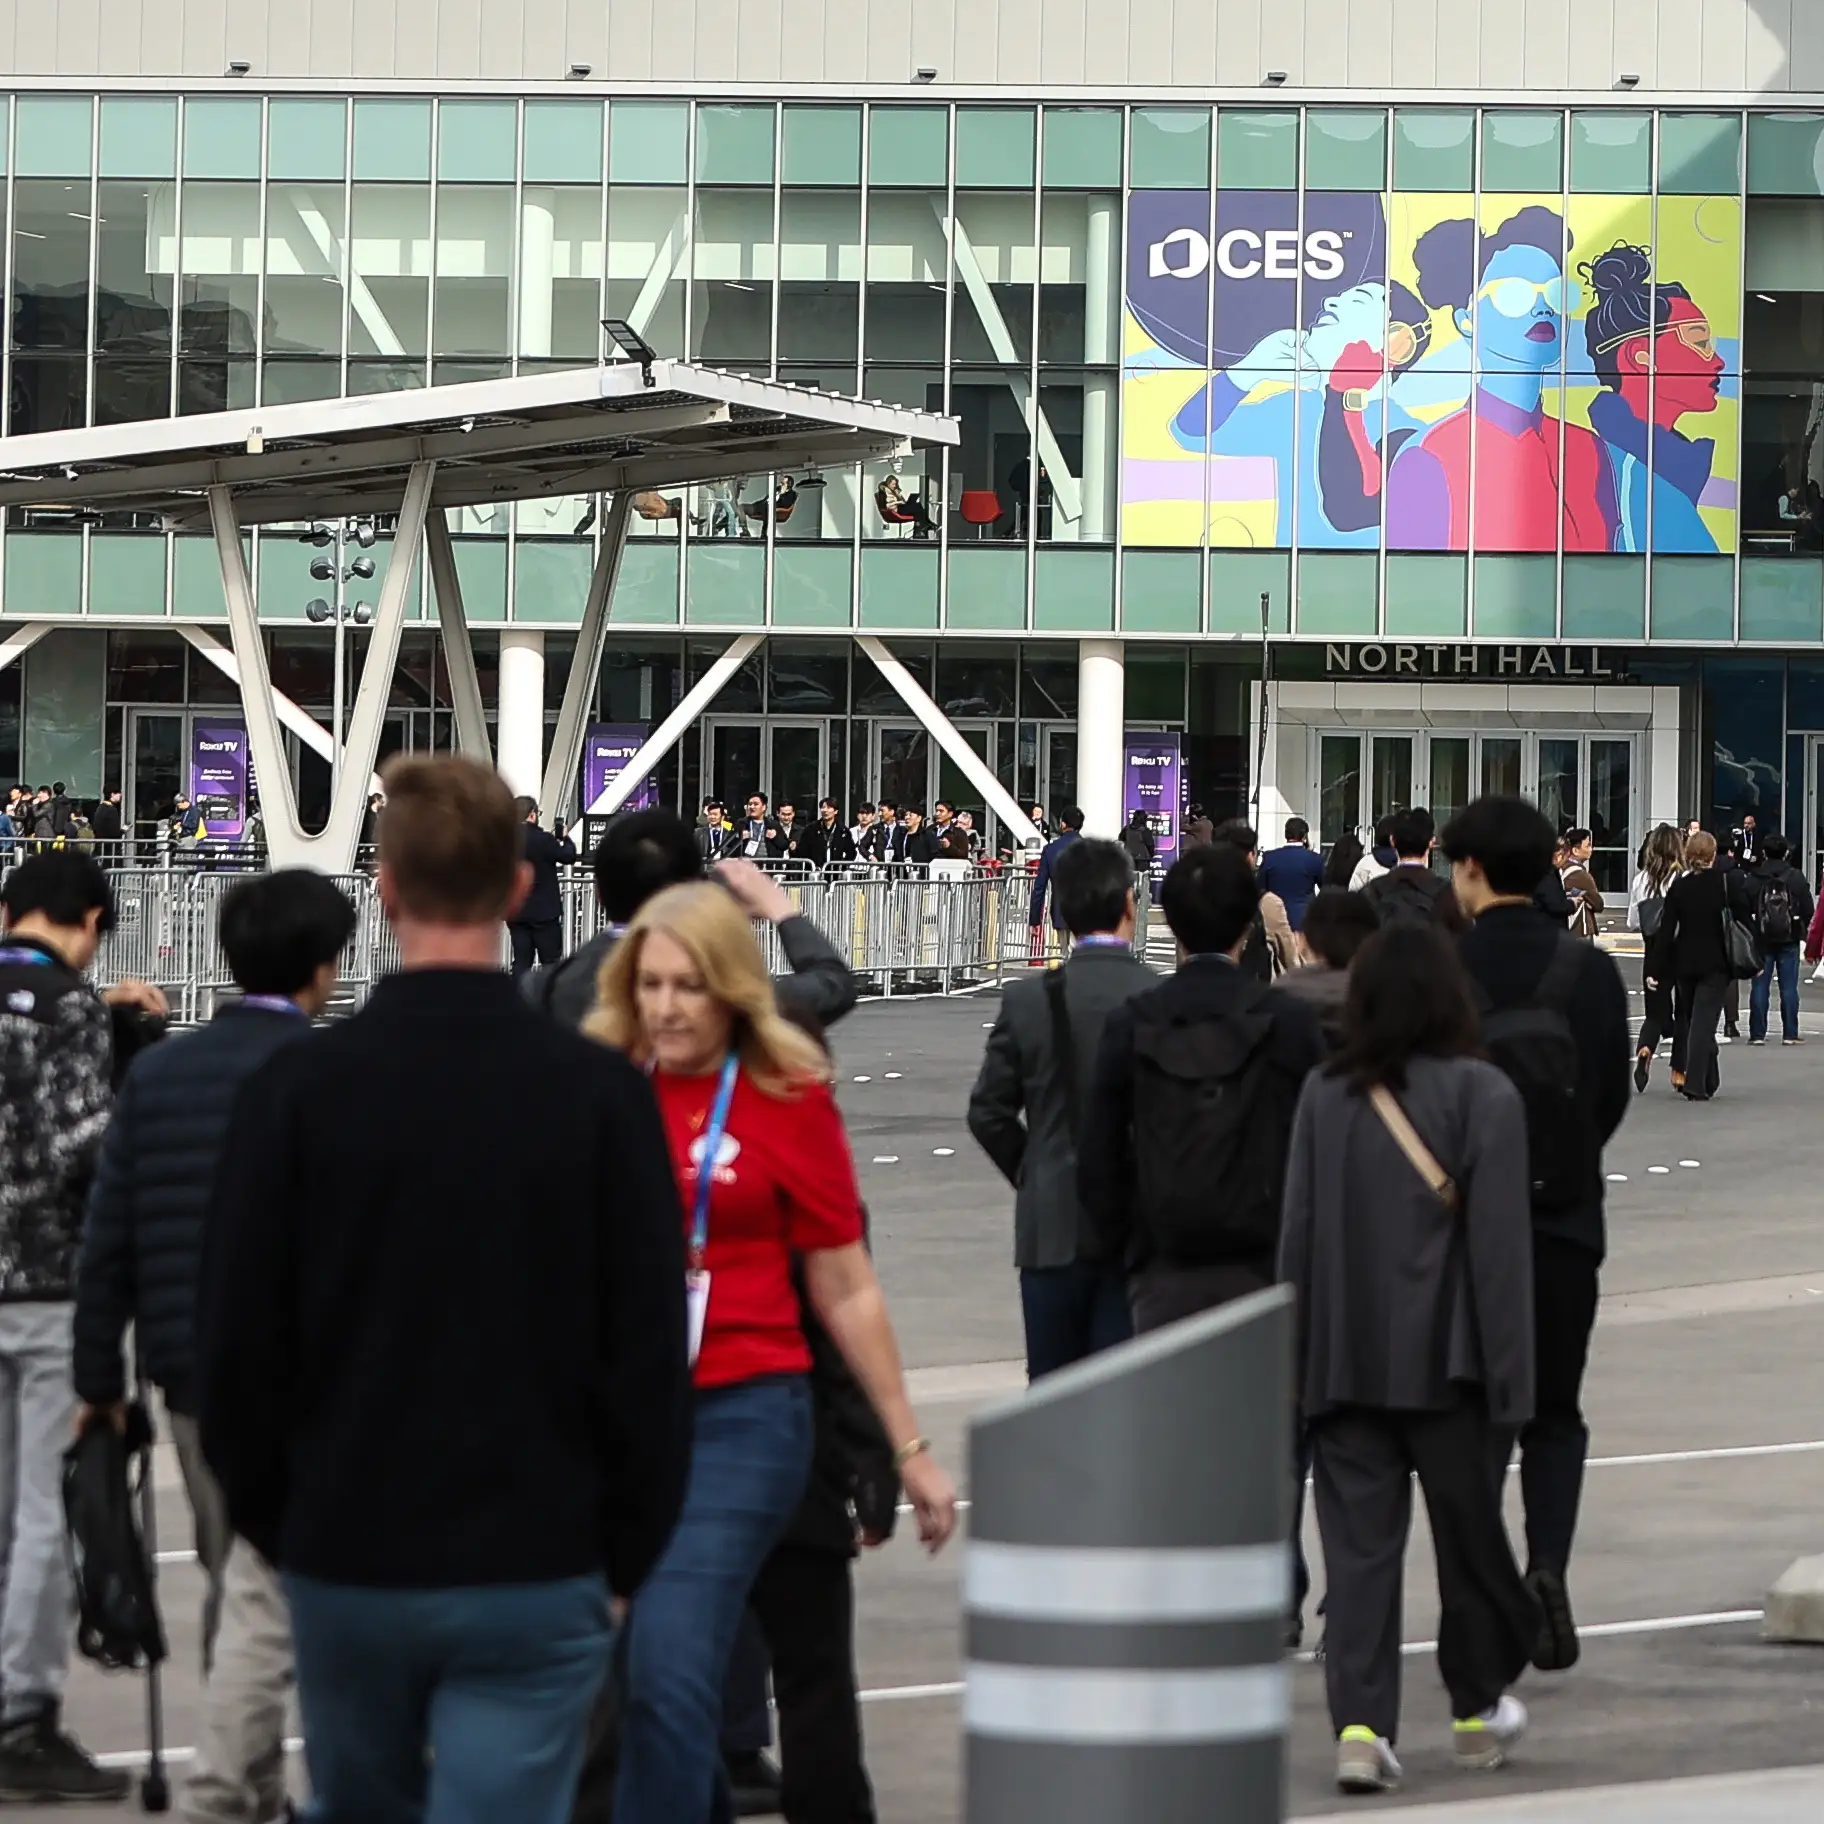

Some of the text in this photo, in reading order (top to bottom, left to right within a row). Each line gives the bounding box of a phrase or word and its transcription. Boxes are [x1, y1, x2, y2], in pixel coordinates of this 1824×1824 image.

[1325, 643, 1612, 675] NORTH HALL
[223, 741, 238, 752] TV
[1156, 755, 1172, 766] TV
